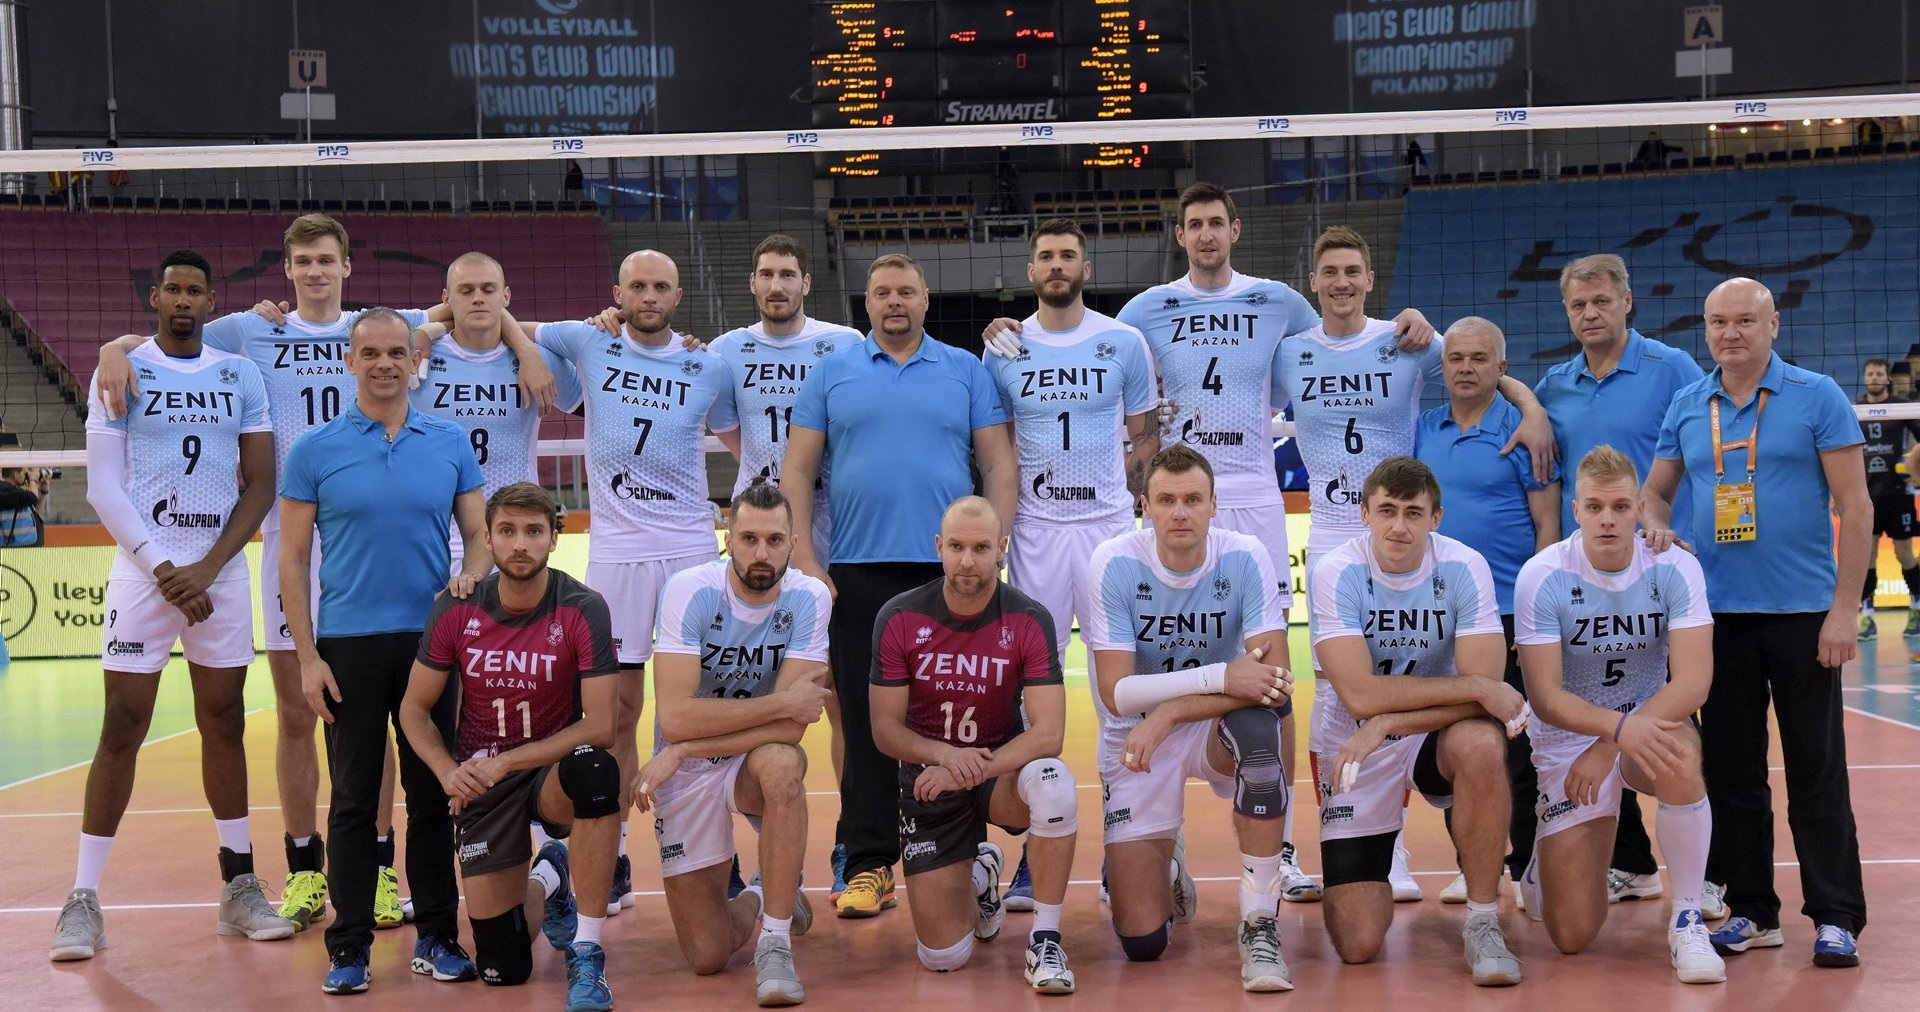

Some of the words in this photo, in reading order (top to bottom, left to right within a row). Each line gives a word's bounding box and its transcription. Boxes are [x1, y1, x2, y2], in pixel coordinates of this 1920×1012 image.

[483, 17, 638, 36] VOLLEYBALL
[1138, 20, 1146, 30] 3
[1403, 5, 1454, 38] CLUB
[1692, 16, 1714, 39] A
[883, 27, 891, 37] 5
[532, 45, 589, 77] CLUB
[1355, 37, 1514, 75] CHAMPIONSHIP
[299, 60, 316, 82] U
[885, 77, 893, 87] 9
[1139, 82, 1147, 93] 9
[1371, 76, 1447, 95] POLAND
[1453, 73, 1497, 91] 2017
[480, 84, 656, 117] CHAMPIONSHIP
[1735, 102, 1767, 113] FIVB
[945, 99, 1058, 122] STRAMATEL
[1496, 111, 1527, 121] FIVB
[1022, 126, 1054, 136] FIVB
[1258, 118, 1290, 129] FIVB
[553, 140, 584, 150] FIVB
[787, 132, 818, 143] FIVB
[82, 151, 114, 162] FIVB
[318, 146, 349, 156] FIVB
[1171, 314, 1259, 343] ZENIT
[1192, 337, 1239, 347] KAZAN
[296, 367, 344, 375] KAZAN
[743, 363, 813, 388] ZENI
[1202, 357, 1223, 395] 4
[602, 367, 691, 406] ZENIT
[760, 386, 800, 394] KAZA
[1020, 368, 1107, 398] ZENIT
[1301, 372, 1392, 402] ZENIT
[144, 390, 233, 417] ZENIT
[300, 386, 340, 425] 10
[621, 395, 670, 411] KAZAN
[1040, 391, 1088, 402] KAZAN
[1323, 398, 1374, 408] KAZAN
[168, 414, 219, 424] KAZAN
[456, 408, 507, 417] KAZAN
[633, 417, 653, 456] 7
[1057, 411, 1070, 450] 1
[1202, 432, 1243, 445] GAZPROM
[1345, 418, 1363, 454] 6
[1868, 423, 1882, 439] 13
[182, 435, 200, 475] 9
[471, 428, 489, 465] 8
[1055, 486, 1096, 500] GAZPROM
[177, 513, 221, 528] GAZPROM
[110, 609, 117, 628] 9
[1136, 611, 1226, 642] ZENIT
[1364, 609, 1447, 640] ZENIT
[1570, 613, 1664, 646] ZENIT
[1160, 637, 1207, 650] KAZAN
[1379, 637, 1429, 649] KAZAN
[1593, 642, 1646, 654] KAZAN
[466, 648, 558, 681] ZENIT
[915, 653, 1009, 686] ZENIT
[1601, 658, 1627, 687] 5
[485, 678, 537, 690] KAZAN
[935, 681, 986, 694] KAZAN
[492, 697, 531, 738] 11
[940, 701, 978, 743] 16
[1042, 773, 1059, 781] errea
